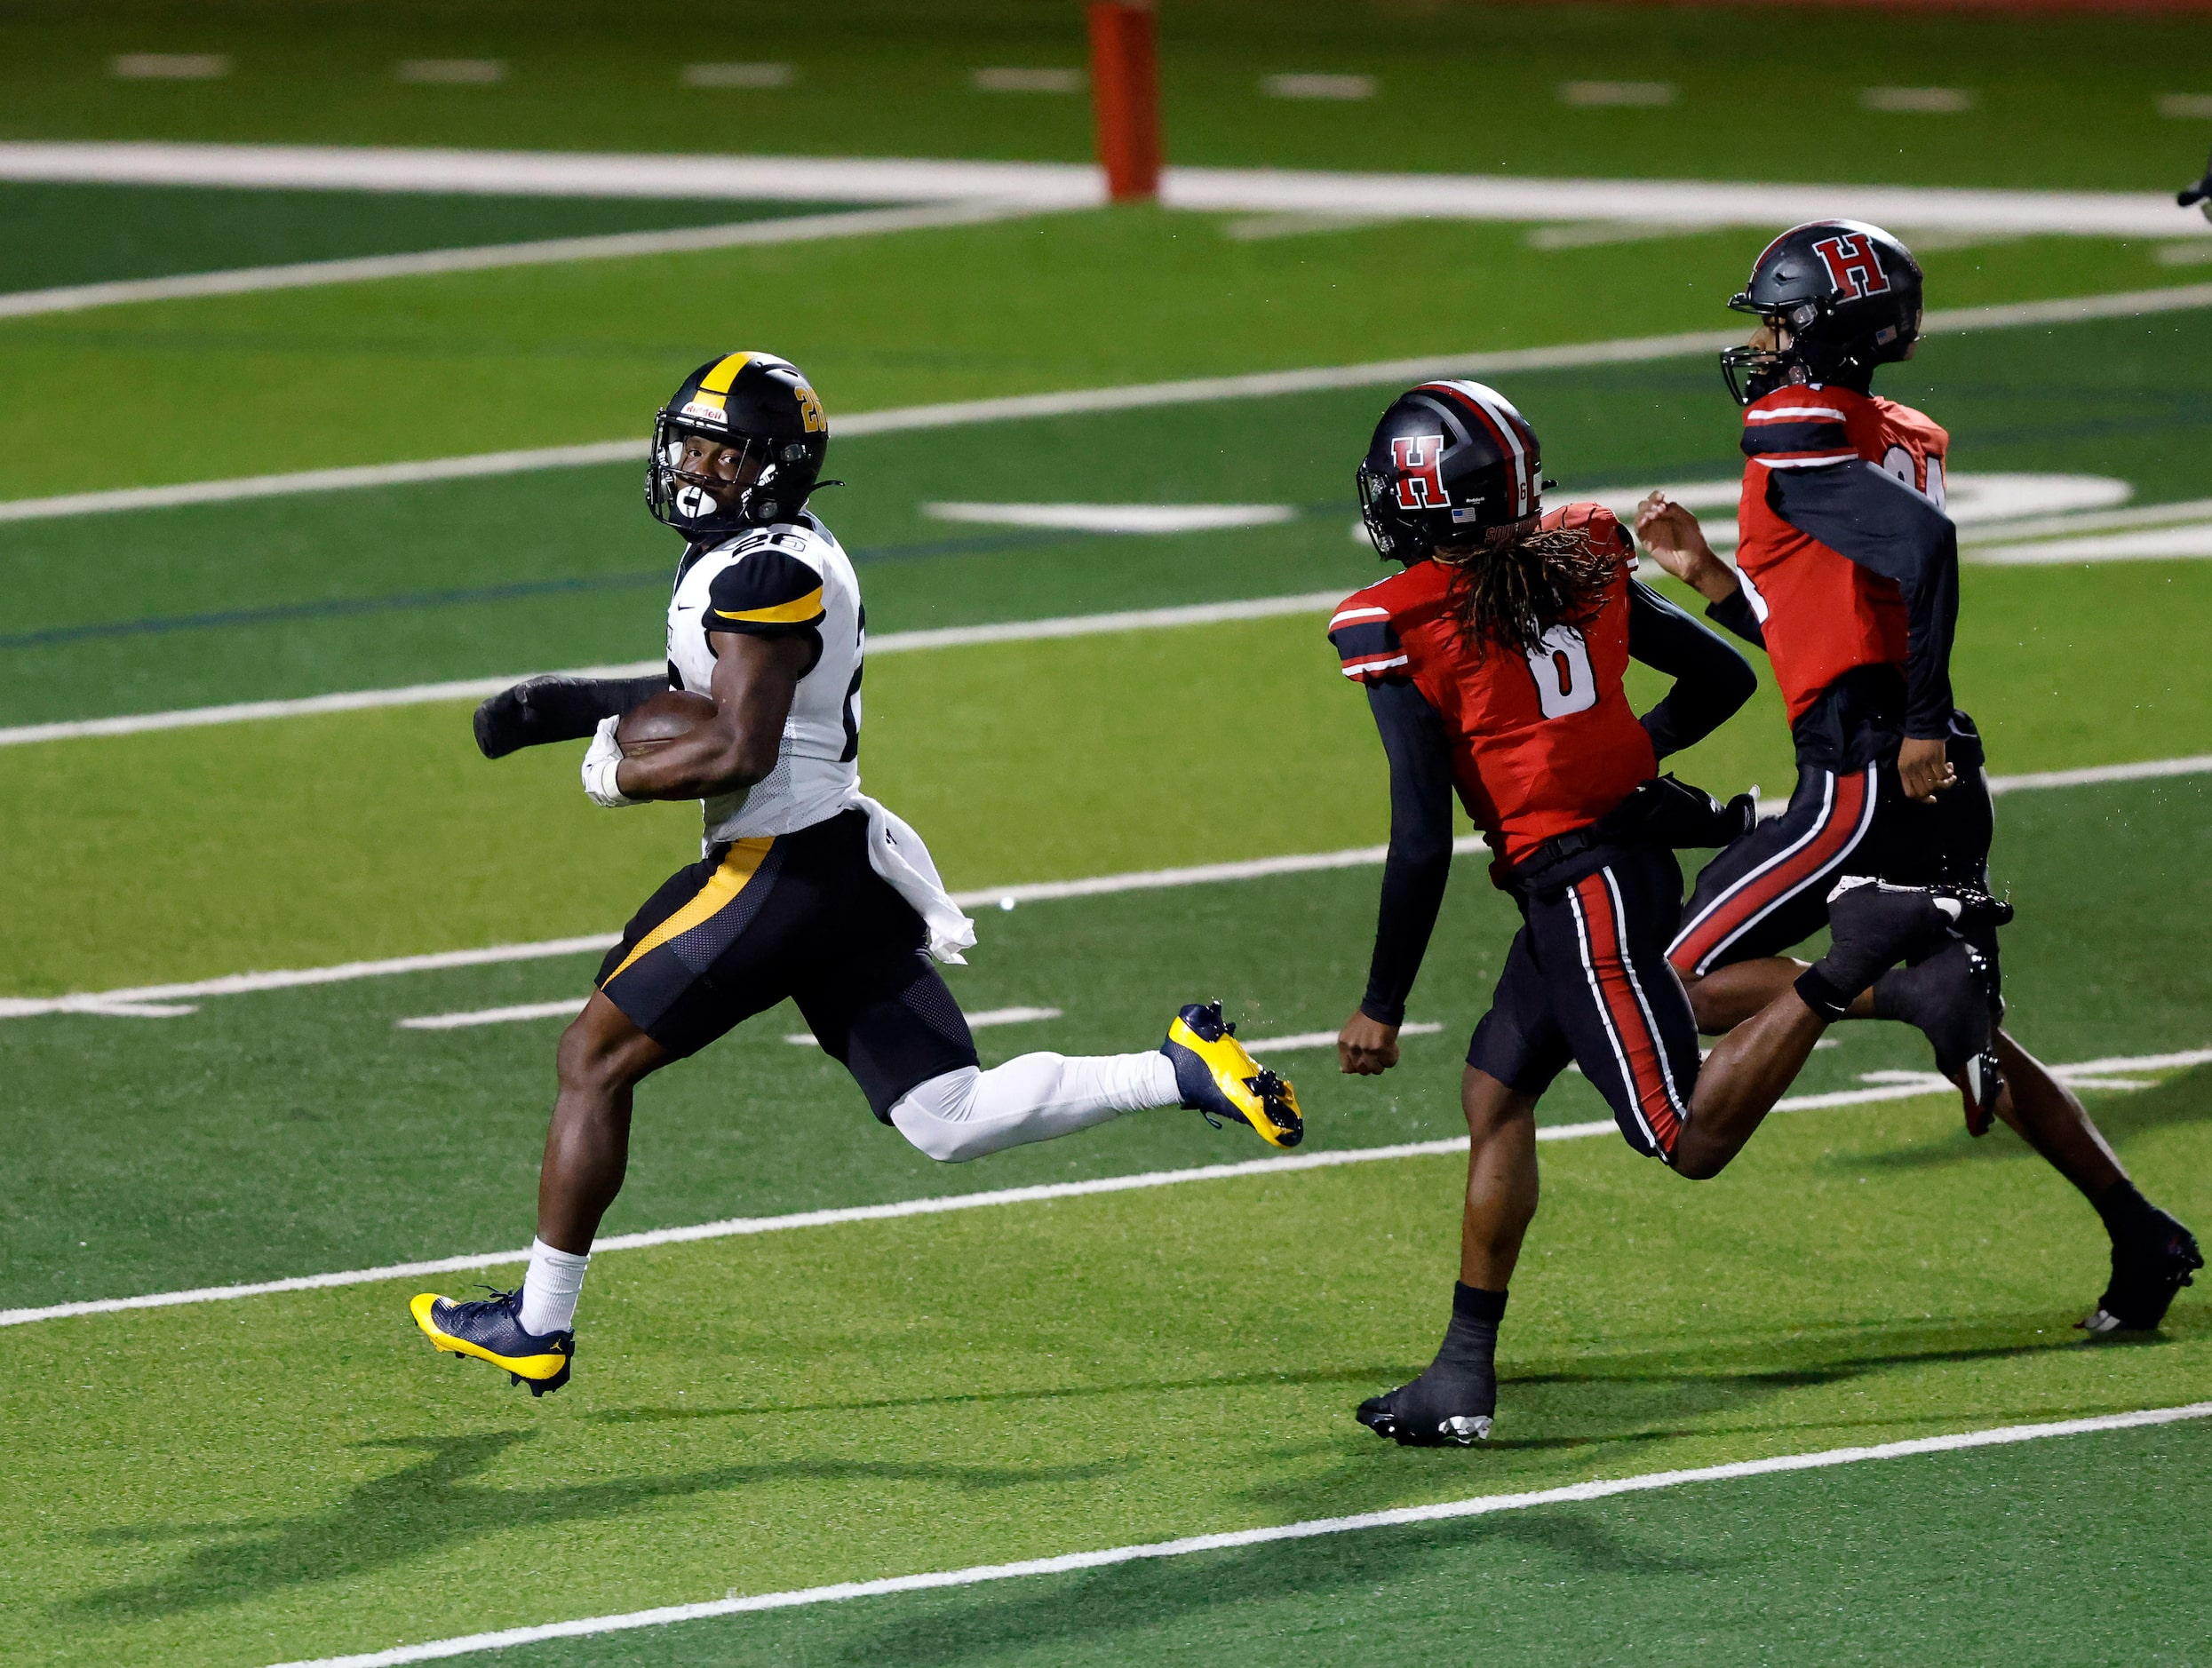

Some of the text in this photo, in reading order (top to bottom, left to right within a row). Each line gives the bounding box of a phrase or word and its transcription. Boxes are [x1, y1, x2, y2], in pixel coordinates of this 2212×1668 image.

[1811, 231, 1891, 305] H
[794, 385, 827, 433] 26
[1391, 434, 1452, 510] H
[731, 532, 808, 558] 26
